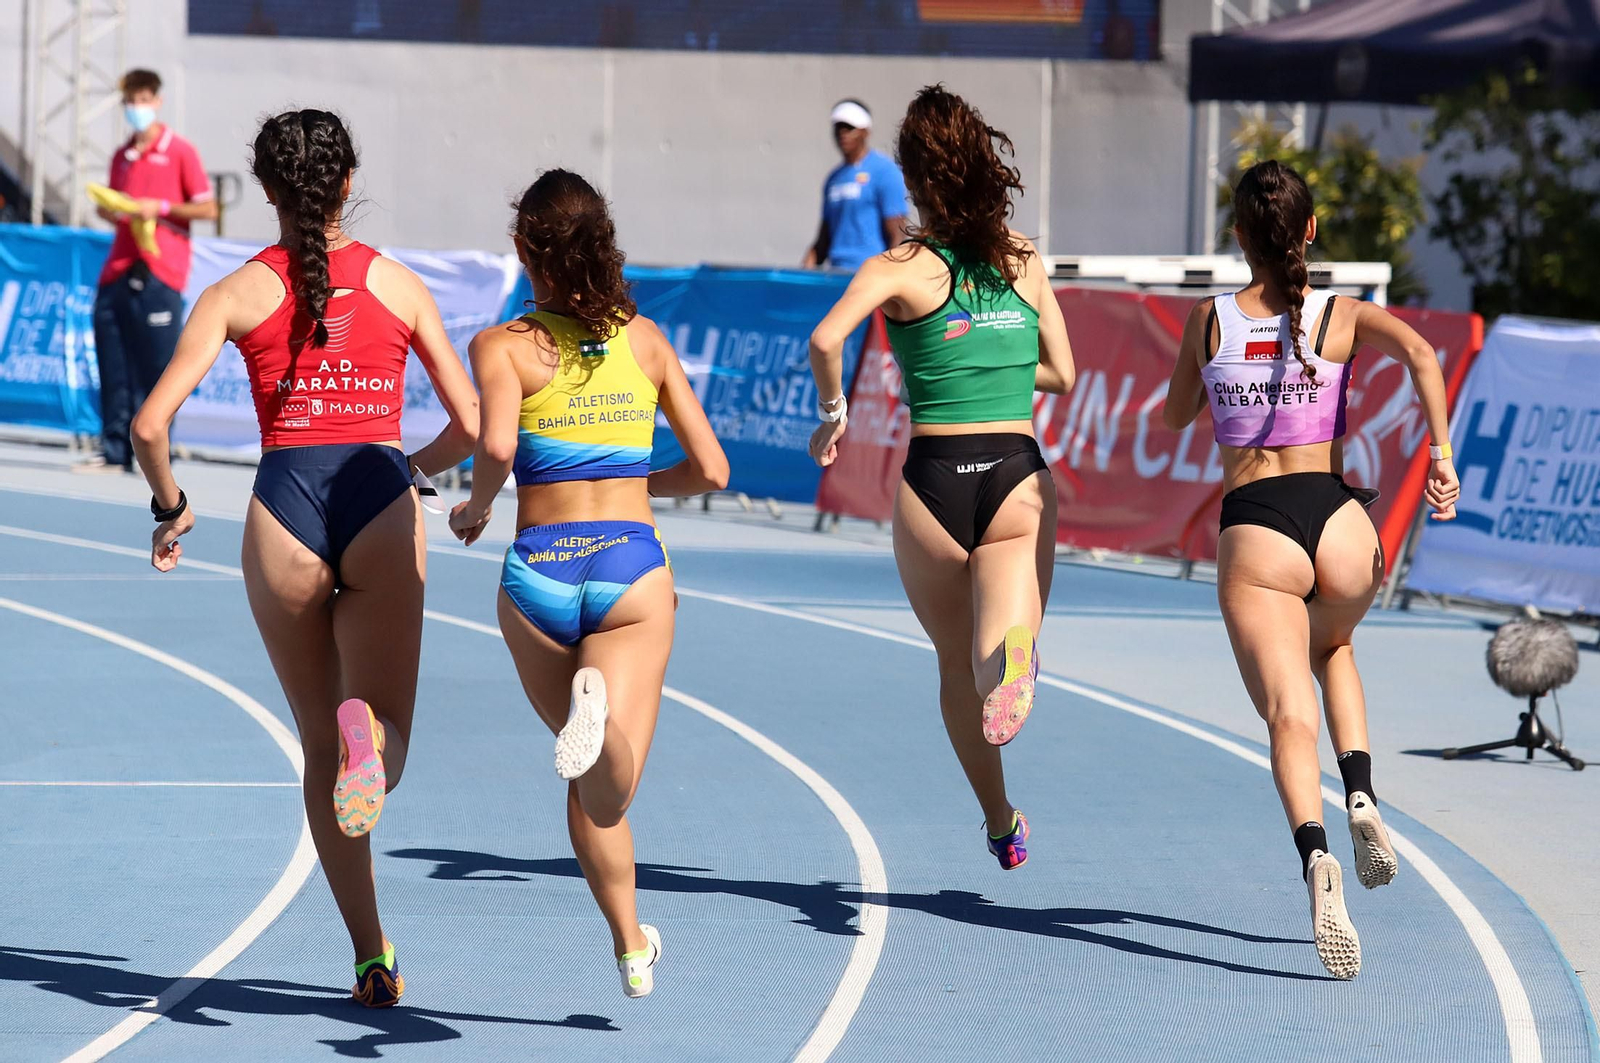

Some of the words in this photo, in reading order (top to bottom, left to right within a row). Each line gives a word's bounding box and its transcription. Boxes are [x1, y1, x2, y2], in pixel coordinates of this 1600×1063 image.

[318, 359, 359, 373] A.D.
[276, 377, 395, 393] MARATHON
[1214, 382, 1245, 395] Club
[1248, 381, 1320, 394] Atletismo
[568, 392, 635, 409] ATLETISMO
[1217, 392, 1319, 407] ALBACETE
[329, 402, 390, 415] MADRID
[538, 413, 576, 430] BAHÍA
[579, 412, 596, 426] DE
[598, 409, 653, 424] ALGECIRAS
[1505, 455, 1548, 503] DE
[527, 549, 557, 564] BAHÍA
[558, 551, 574, 562] DE
